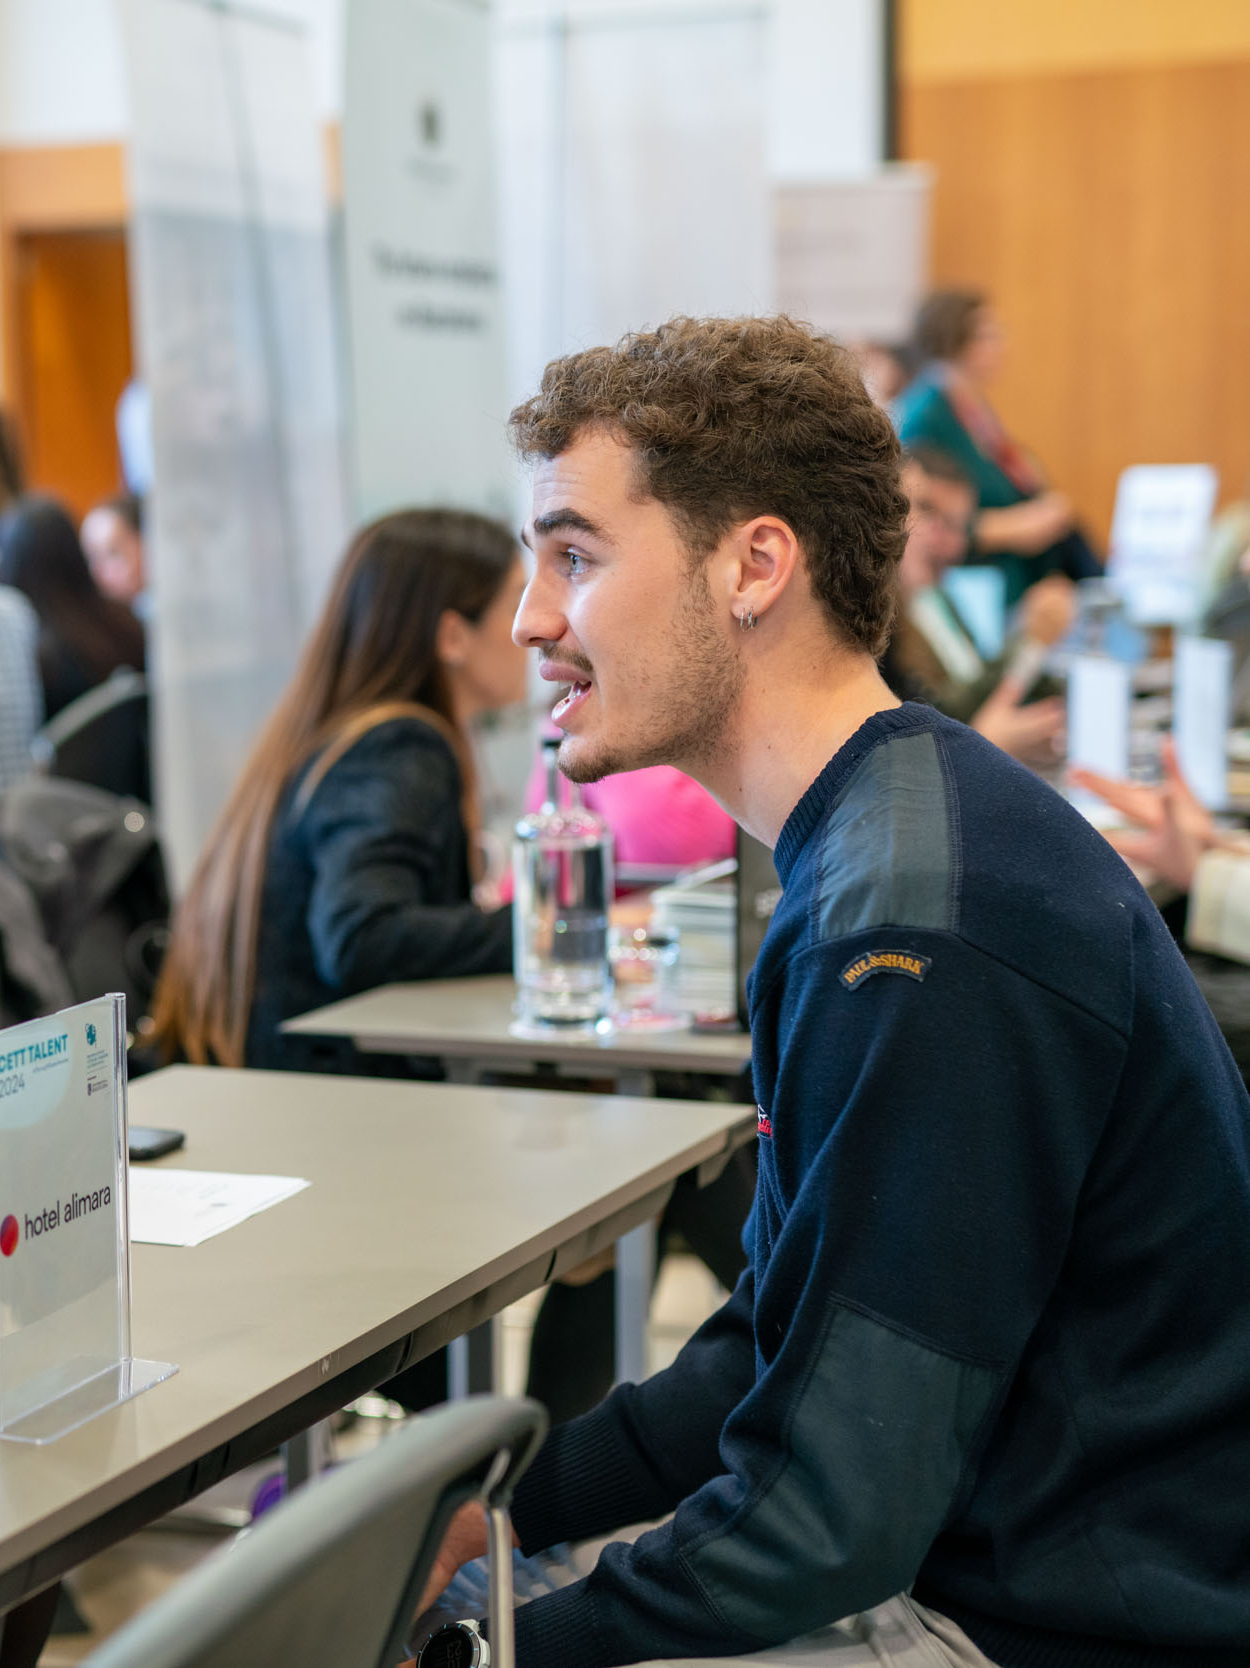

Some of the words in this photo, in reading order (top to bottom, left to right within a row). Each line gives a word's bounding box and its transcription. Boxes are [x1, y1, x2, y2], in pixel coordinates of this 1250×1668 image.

[27, 1033, 68, 1063] TALENT
[24, 1199, 60, 1241] hotel
[64, 1185, 111, 1224] alimara
